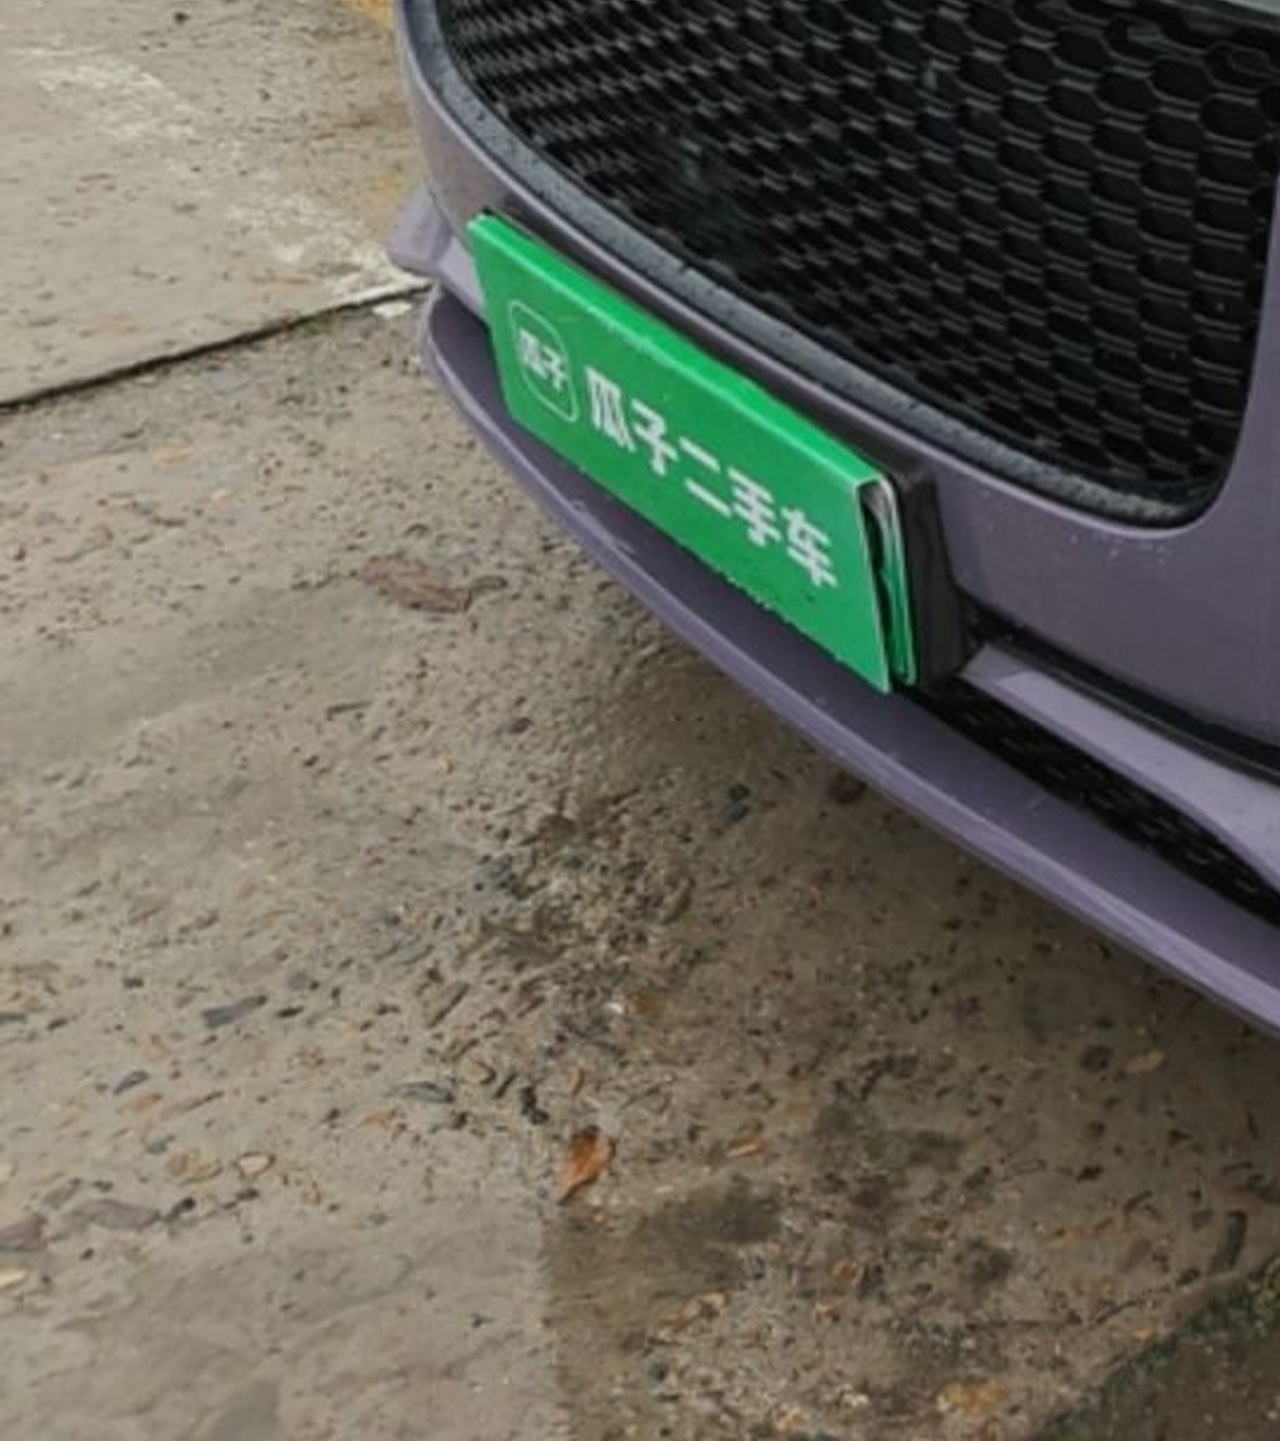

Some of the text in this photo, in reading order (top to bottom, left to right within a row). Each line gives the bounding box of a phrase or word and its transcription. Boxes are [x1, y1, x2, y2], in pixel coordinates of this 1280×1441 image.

[519, 328, 568, 390] 瓜子
[586, 364, 838, 588] 瓜子二手车
